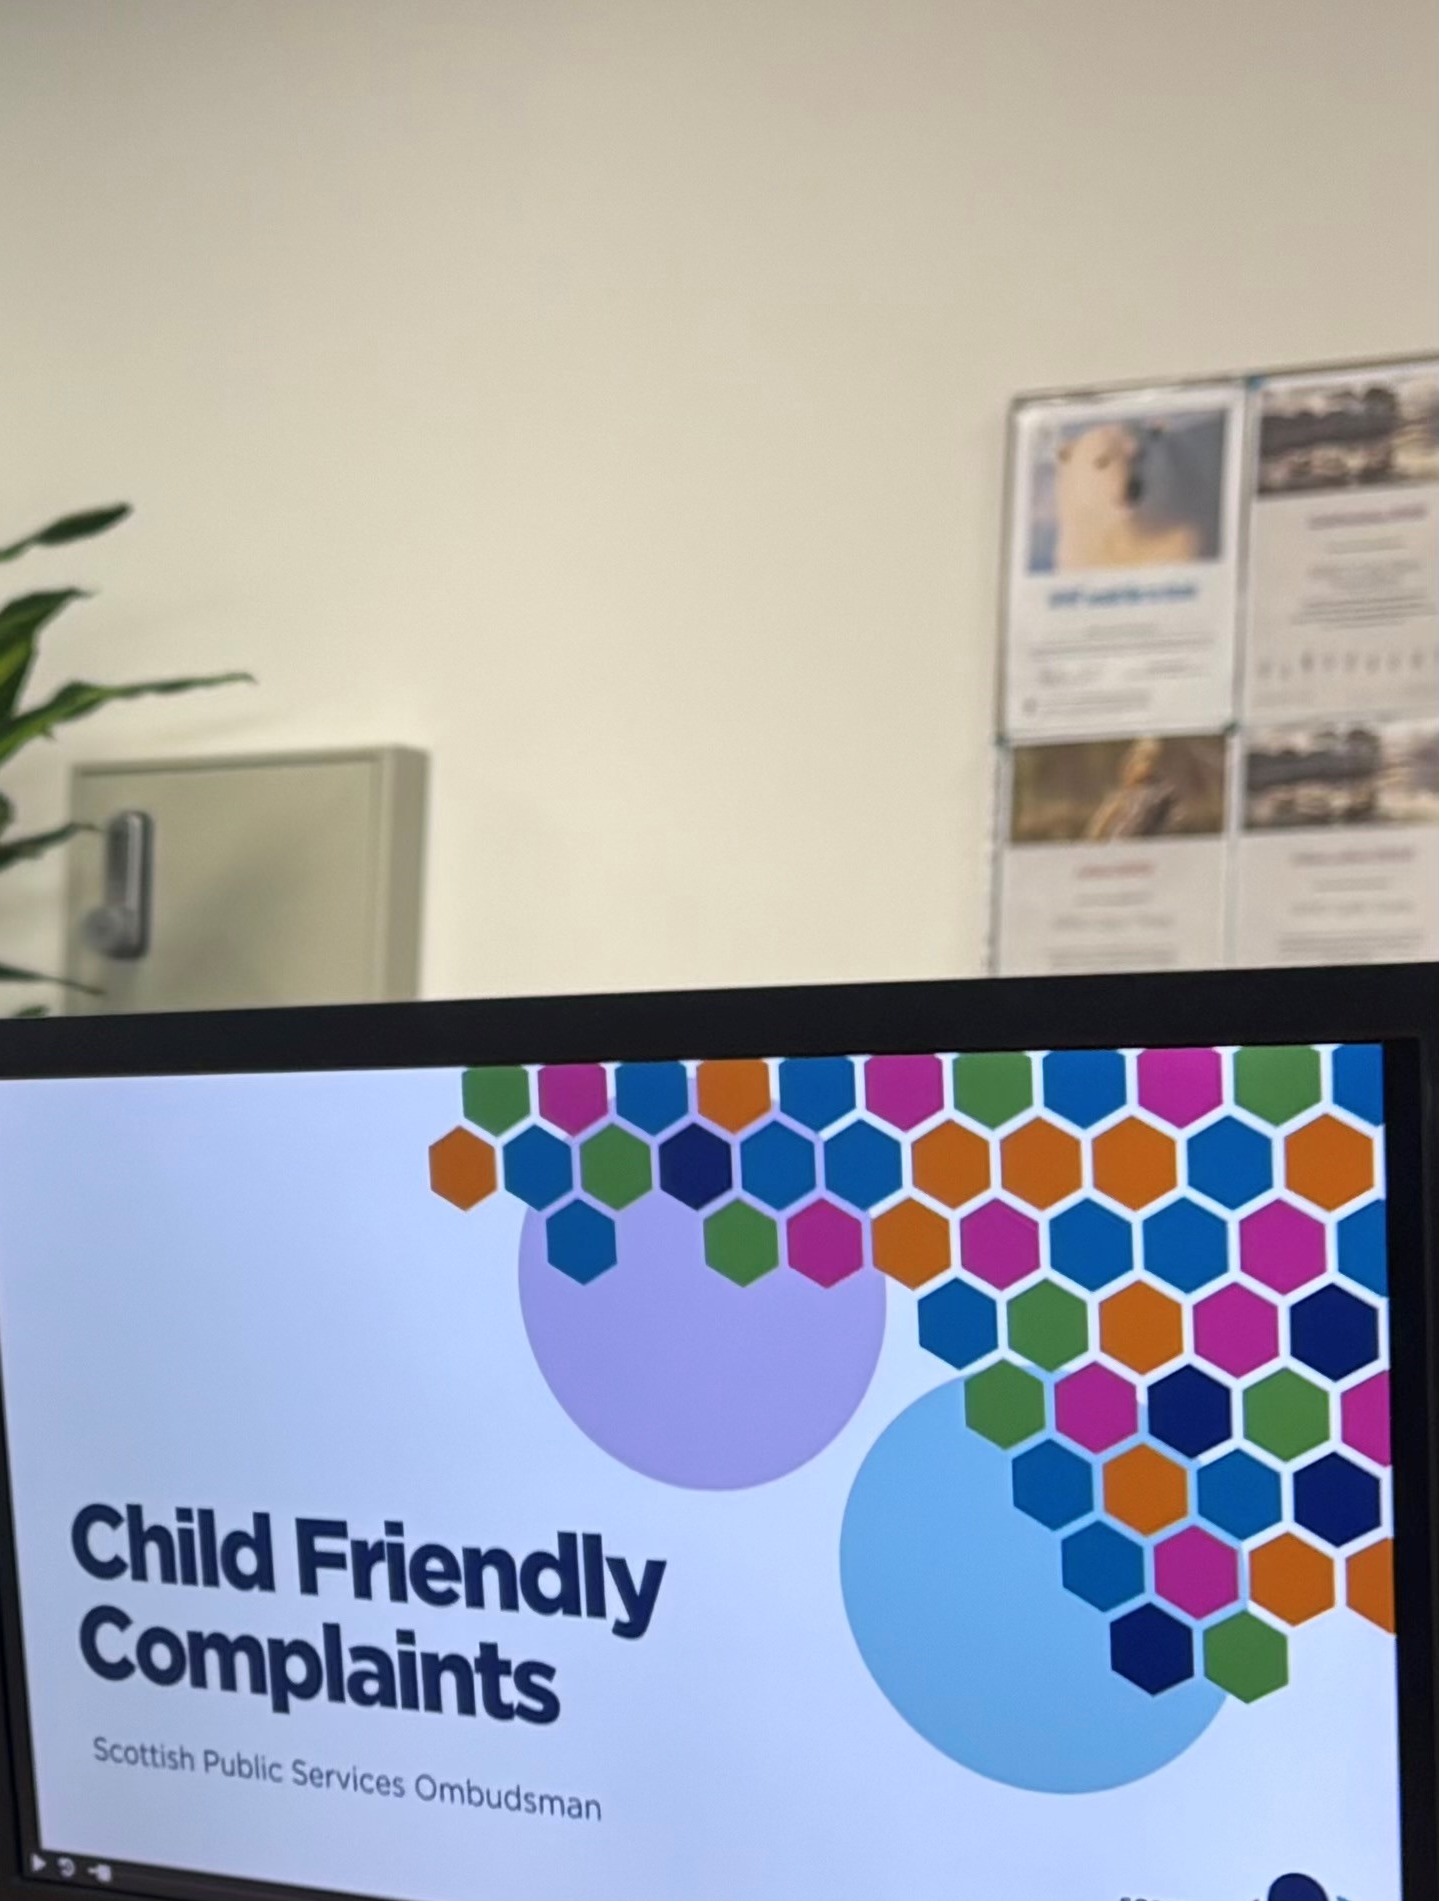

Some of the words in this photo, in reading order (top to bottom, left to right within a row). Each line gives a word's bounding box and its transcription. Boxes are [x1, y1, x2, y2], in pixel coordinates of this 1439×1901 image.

[72, 1504, 275, 1593] Child
[295, 1516, 667, 1638] Friendly
[79, 1605, 561, 1724] Complaints
[92, 1736, 195, 1773] Scottish
[203, 1750, 283, 1784] Public
[291, 1760, 405, 1798] Services
[415, 1773, 603, 1822] Ombudsman
